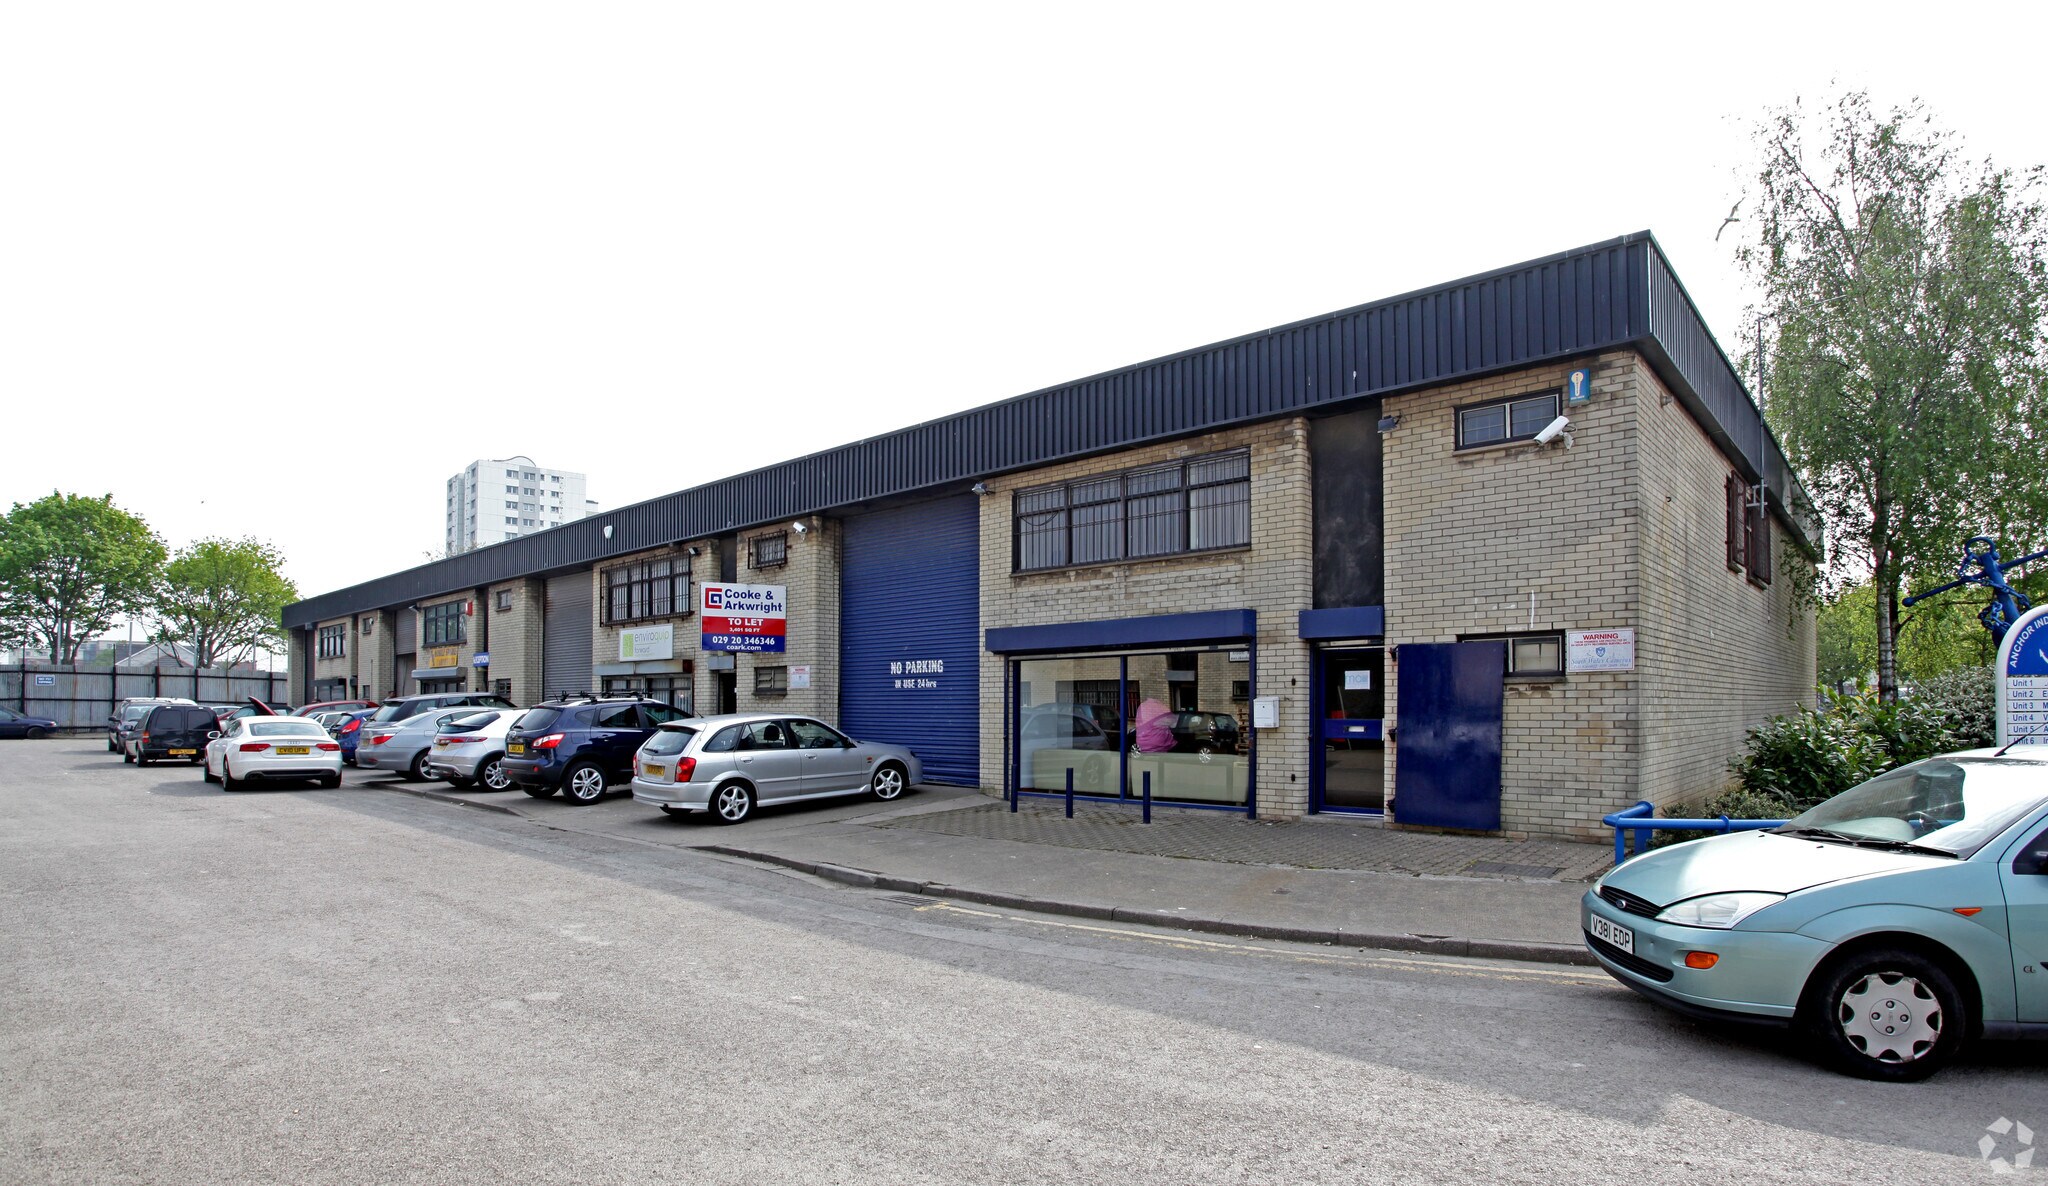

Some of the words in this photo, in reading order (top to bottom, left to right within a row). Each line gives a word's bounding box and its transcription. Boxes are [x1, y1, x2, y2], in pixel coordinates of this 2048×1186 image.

[724, 588, 761, 600] Cooke
[765, 590, 774, 600] &
[724, 600, 783, 614] Arkwright
[728, 618, 742, 626] TO
[744, 618, 764, 626] LET
[712, 635, 729, 644] 029
[731, 636, 742, 644] 20
[744, 637, 776, 645] 346346
[2009, 625, 2036, 668] ANCHOR
[890, 661, 903, 675] NO
[905, 659, 944, 674] PARKING
[903, 679, 915, 689] USE
[2012, 679, 2027, 687] Unit
[2029, 679, 2034, 687] 1
[2012, 690, 2027, 698] Unit
[2029, 690, 2034, 698] 2
[2012, 701, 2027, 710] Unit
[2029, 701, 2034, 710] 3
[2012, 713, 2027, 721] Unit
[2029, 713, 2034, 721] 4
[2013, 725, 2028, 733] Unit
[2029, 736, 2035, 745] 6
[1592, 916, 1611, 940] V381
[1613, 926, 1630, 948] EDP
